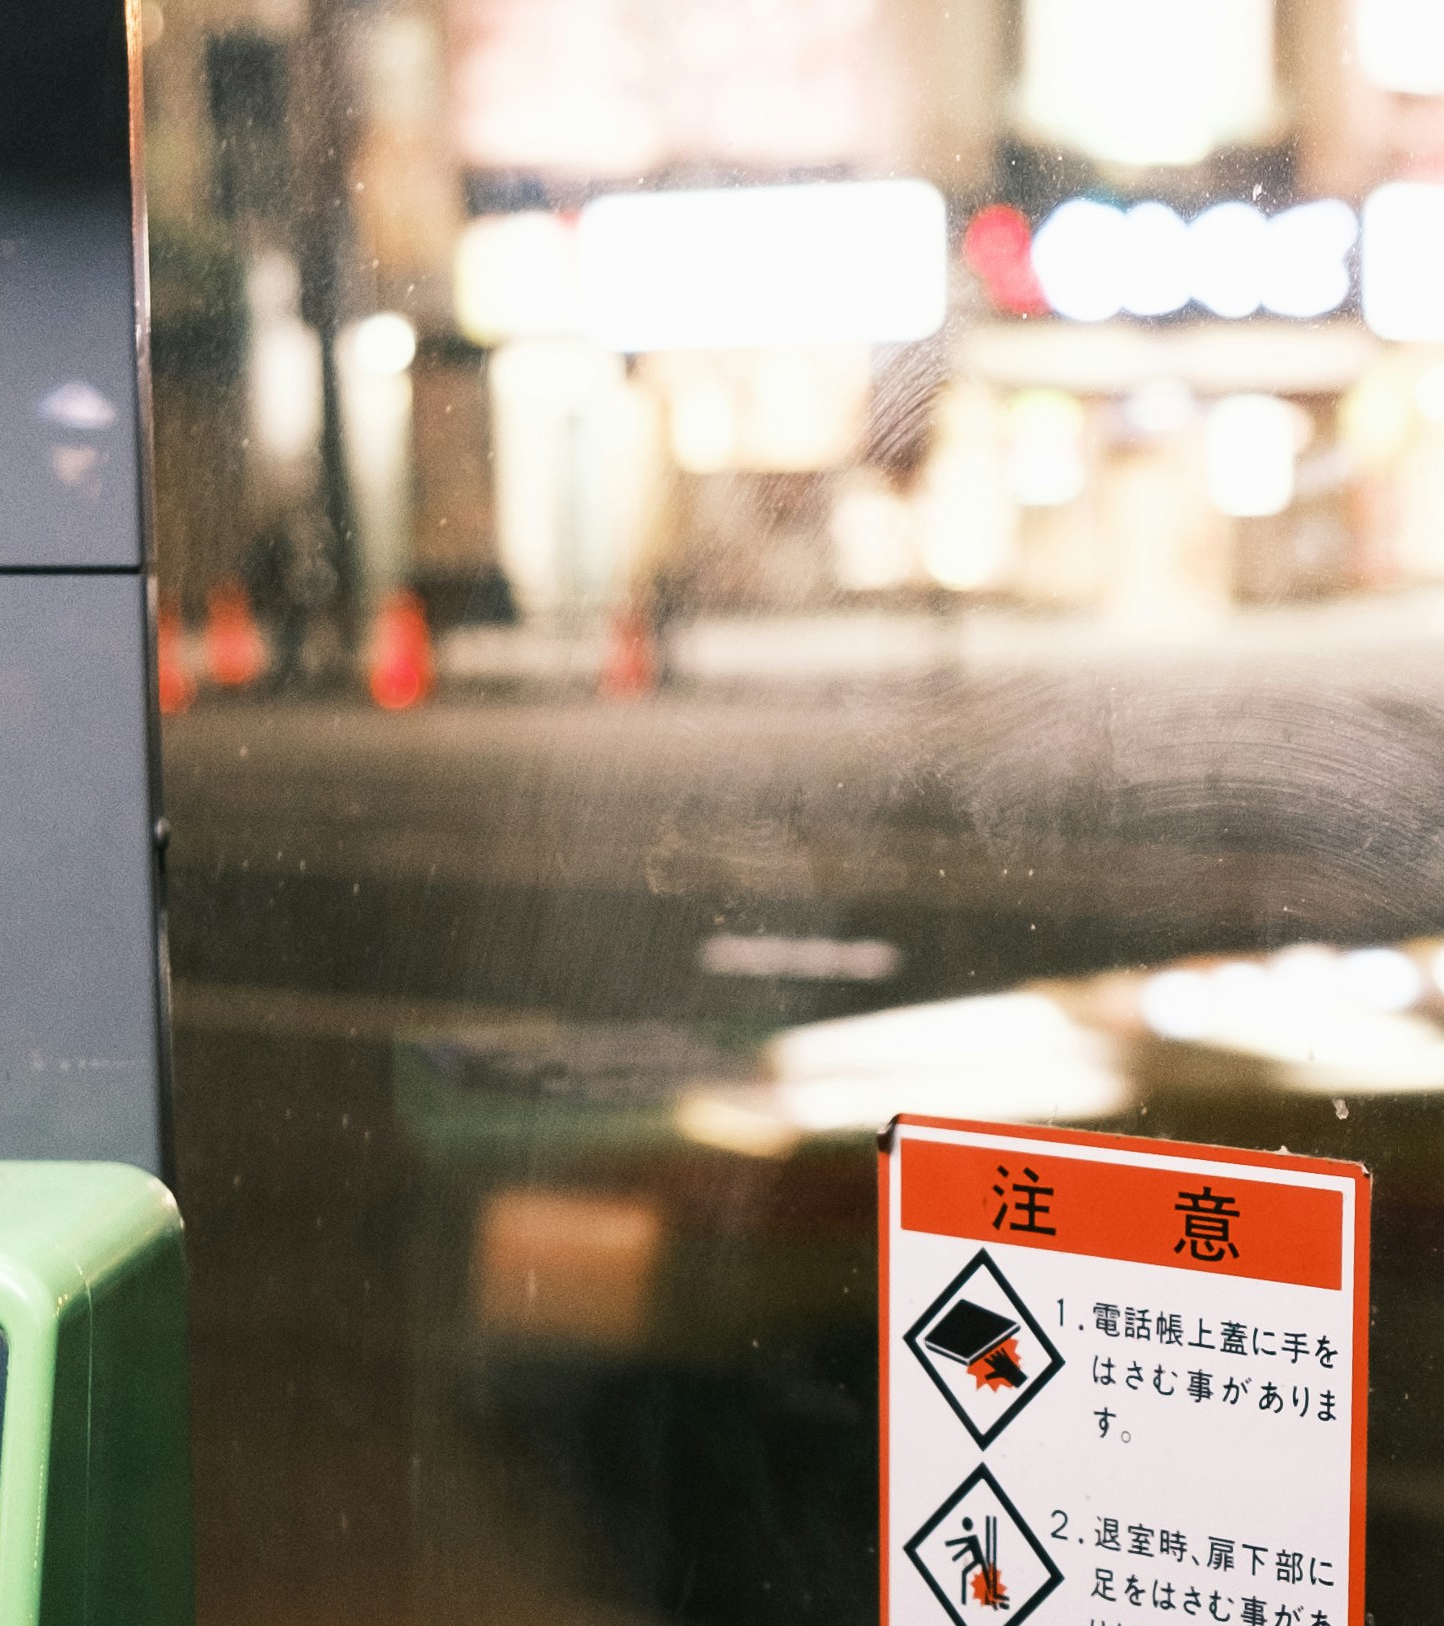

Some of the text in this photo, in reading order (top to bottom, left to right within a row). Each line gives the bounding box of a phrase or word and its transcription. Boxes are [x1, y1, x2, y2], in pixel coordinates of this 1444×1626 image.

[1092, 1354, 1338, 1423] はさむ事がありま
[1092, 1407, 1132, 1444] す。
